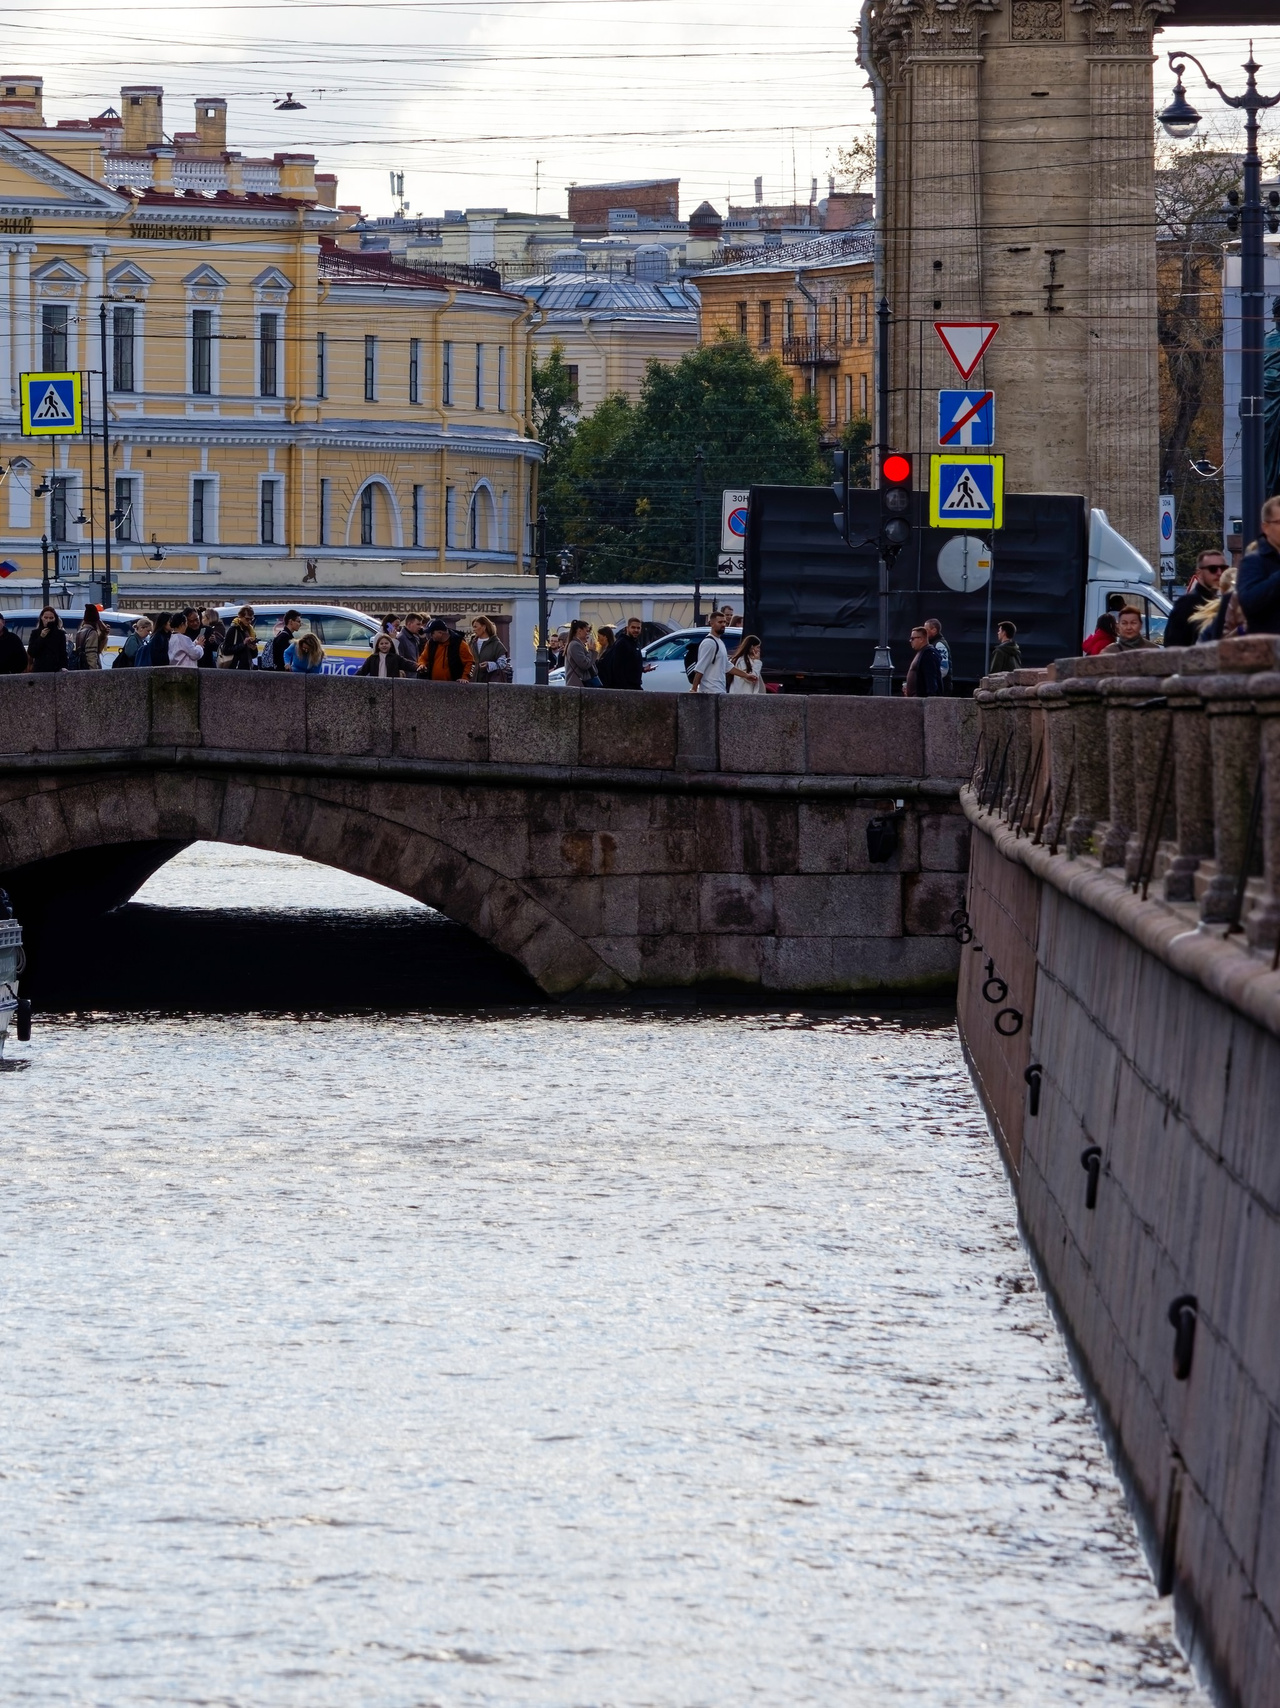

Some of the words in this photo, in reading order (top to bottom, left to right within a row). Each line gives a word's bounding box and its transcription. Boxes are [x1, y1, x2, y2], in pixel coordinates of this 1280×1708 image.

[61, 555, 77, 571] СТОП
[118, 599, 234, 610] АНКТ-ПЕТЕРБУРГСКИ
[342, 600, 431, 613] ЭКОНОМИЧЕСКИЙ
[432, 602, 503, 613] УНИВЕРСИТЕТ
